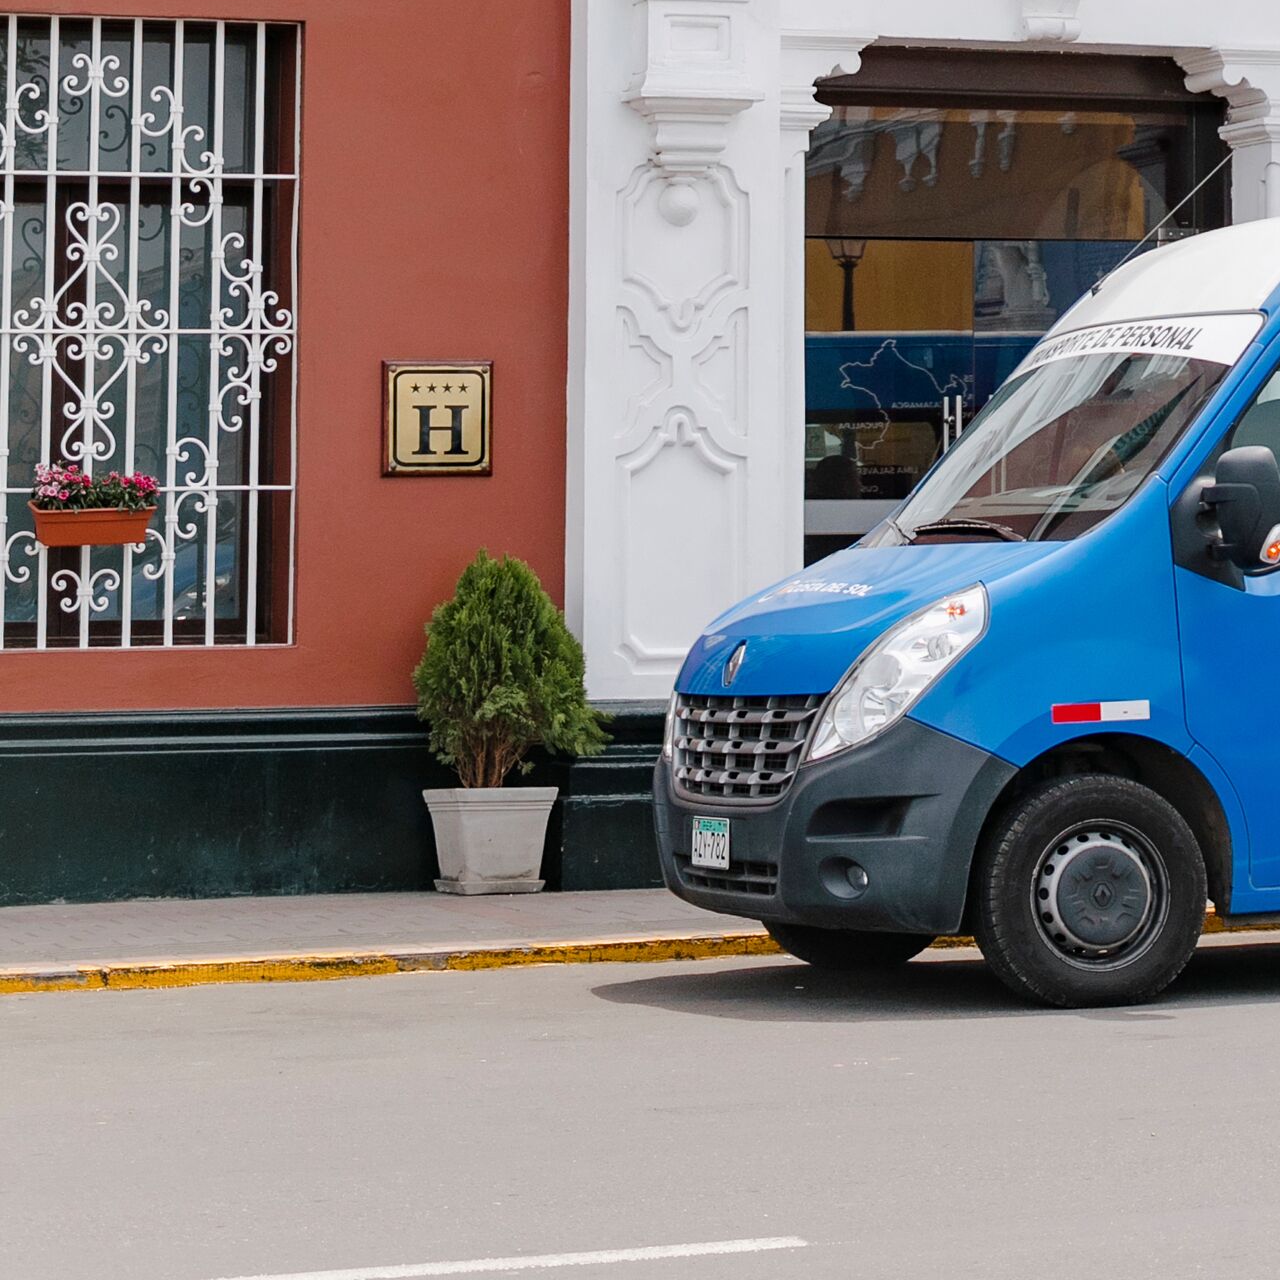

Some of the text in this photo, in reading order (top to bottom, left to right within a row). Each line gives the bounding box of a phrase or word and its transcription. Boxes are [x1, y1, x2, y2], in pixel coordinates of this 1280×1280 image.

[1090, 327, 1124, 349] DE
[1111, 326, 1202, 351] PERSONAL
[411, 404, 470, 455] H
[693, 830, 726, 860] AZY-782
